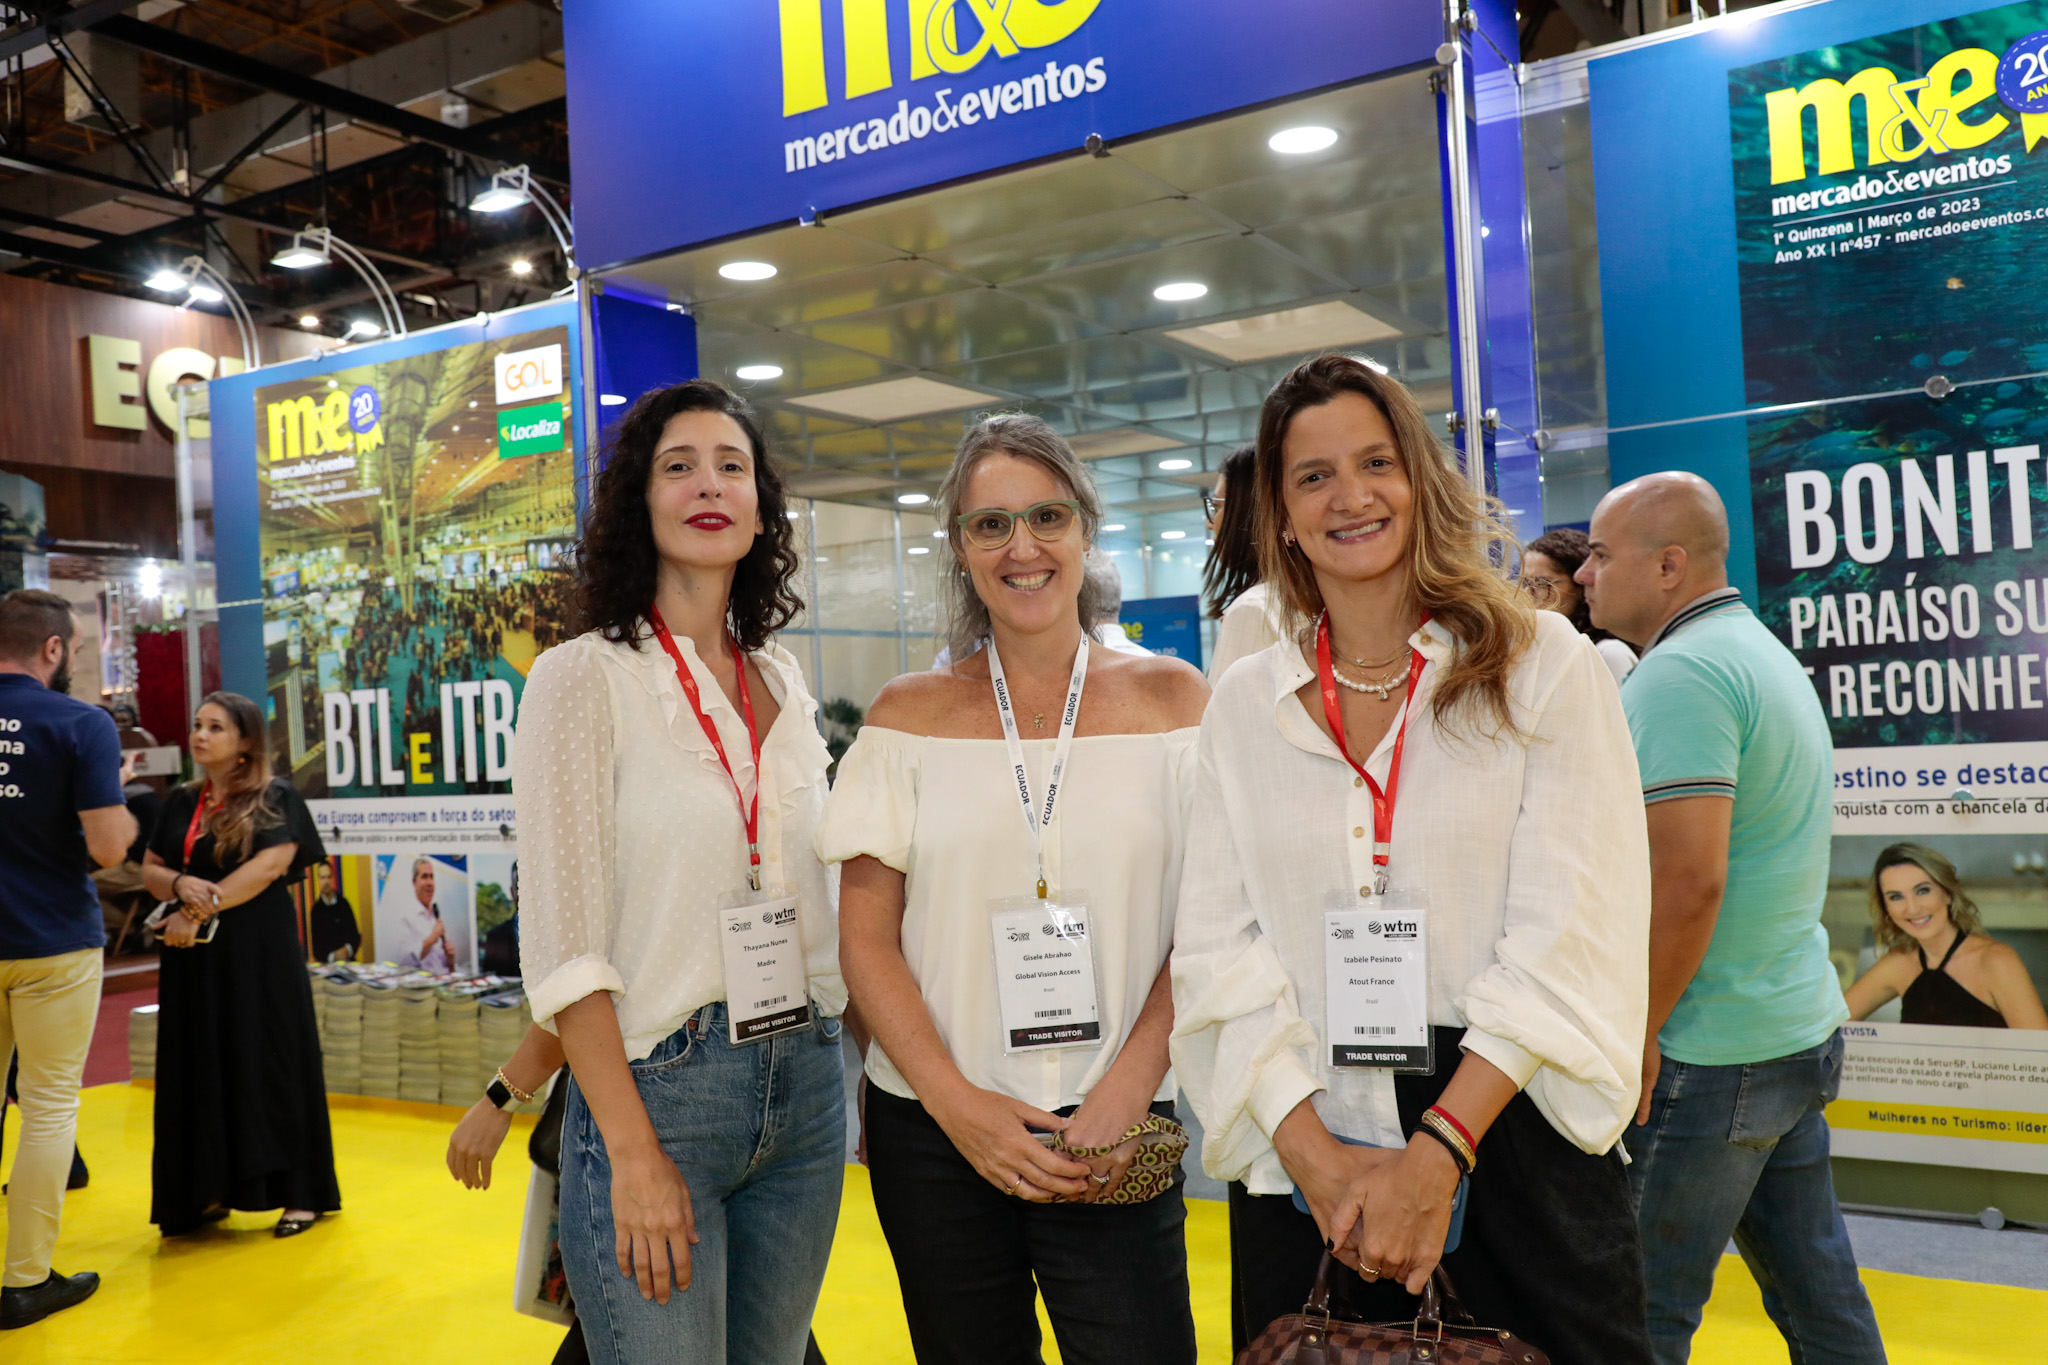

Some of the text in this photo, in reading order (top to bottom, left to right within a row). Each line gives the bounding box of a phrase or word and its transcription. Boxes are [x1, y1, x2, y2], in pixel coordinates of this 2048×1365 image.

[785, 57, 1107, 173] mercado&eventos
[1765, 48, 2010, 185] m&e
[1771, 154, 2012, 216] mercado&eventos
[1788, 222, 1854, 243] Quinzena
[1867, 211, 1912, 230] Março
[1917, 207, 1936, 220] de
[1941, 197, 1981, 215] 2023
[1775, 249, 1802, 264] Ano
[1806, 243, 1826, 258] XX
[505, 358, 552, 391] GOL
[352, 392, 374, 419] 20
[510, 418, 561, 442] Localiza
[1785, 444, 2048, 569] BONIT
[1790, 572, 1981, 649] PARAÍSO
[995, 677, 1010, 712] ECUADOR
[1829, 653, 2048, 718] RECONHE
[1064, 692, 1078, 726] ECUADOR
[324, 679, 515, 787] BTL E ITB
[1015, 764, 1030, 805] ECUADOR
[1917, 768, 1947, 787] se
[1957, 763, 2048, 786] destac
[1042, 783, 1057, 826] ECUADOR
[1894, 803, 1929, 815] com
[1936, 803, 1945, 815] a
[1952, 800, 2027, 815] chancela
[331, 810, 365, 826] Europa
[368, 811, 426, 826] comprovam
[440, 808, 467, 825] força
[471, 808, 485, 821] do
[774, 908, 796, 920] wtm
[1384, 920, 1417, 932] wtm
[743, 938, 788, 953] Thayana Nunes
[757, 958, 777, 968] Madre
[1023, 951, 1072, 962] Gisele Abrahao
[1370, 955, 1402, 964] Pesinato
[1015, 972, 1037, 980] Global
[1038, 970, 1058, 978] Vision
[1349, 978, 1395, 986] Atout France
[748, 1014, 796, 1033] TRADE VISITOR
[1028, 1029, 1083, 1041] TRADE VISITOR
[1345, 1052, 1408, 1062] TRADE VISITOR
[1866, 1055, 1911, 1066] executiva
[1913, 1058, 1925, 1066] da
[1972, 1060, 2010, 1071] Luciane
[2013, 1062, 2038, 1073] Leite
[1856, 1074, 1899, 1085] enfrentar
[1901, 1078, 1914, 1086] no
[1916, 1079, 1939, 1087] novo
[1896, 1066, 1908, 1075] do
[1911, 1067, 1942, 1077] estado
[1945, 1070, 1951, 1078] e
[1954, 1070, 1982, 1080] revela
[1984, 1071, 2017, 1082] planos
[2019, 1074, 2025, 1082] e
[1869, 1110, 1927, 1125] Mulheres
[1932, 1116, 1948, 1126] no
[1953, 1116, 2011, 1132] Turismo:
